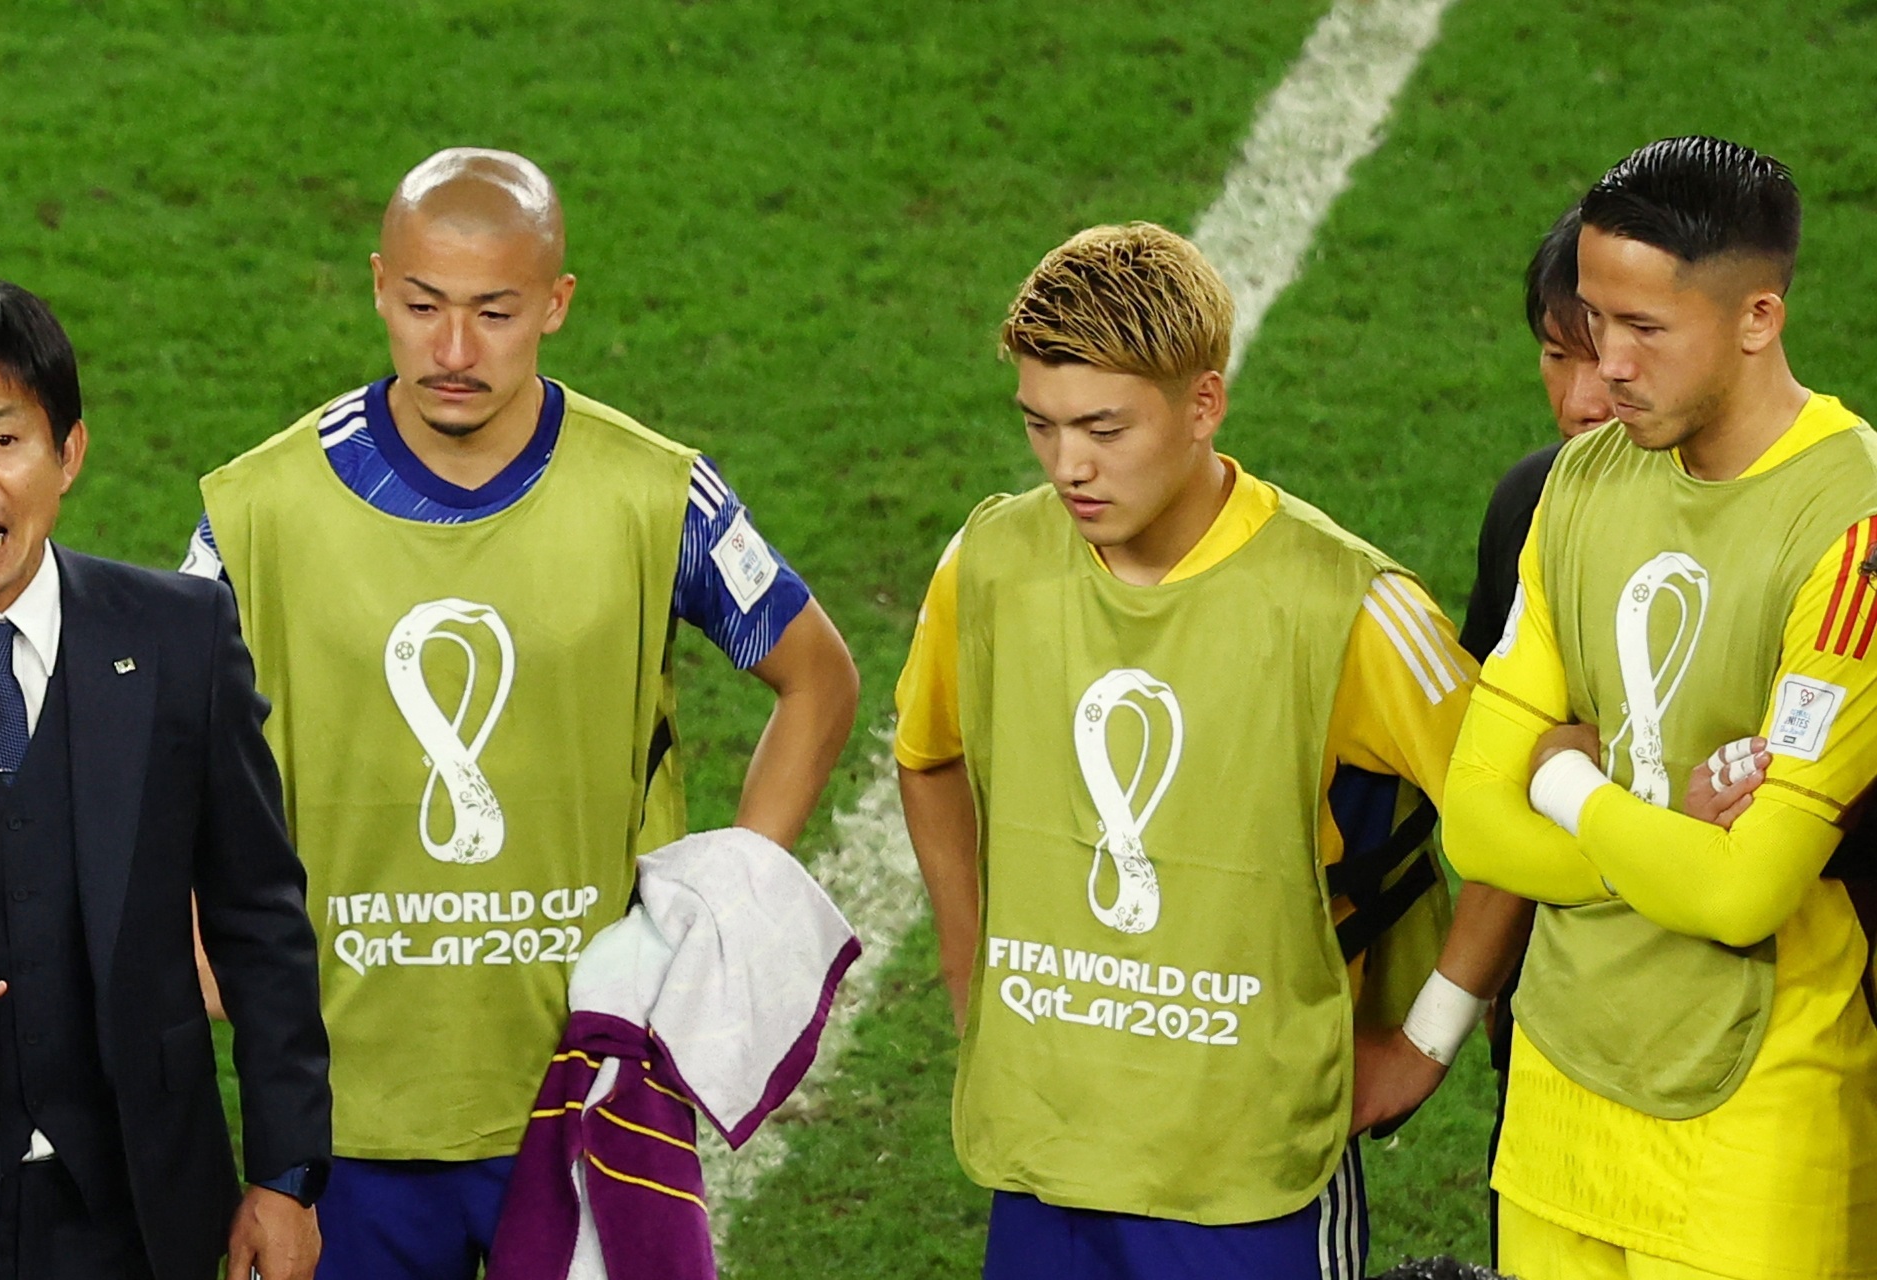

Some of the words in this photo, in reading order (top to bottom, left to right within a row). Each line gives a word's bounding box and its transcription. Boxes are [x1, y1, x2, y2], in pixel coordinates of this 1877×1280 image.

[395, 890, 535, 923] WORLD
[541, 885, 599, 921] CUP
[334, 926, 582, 976] Qatar2022
[988, 937, 1058, 977] FIFA
[1063, 948, 1186, 997] WORLD
[1191, 970, 1261, 1005] CUP
[999, 975, 1239, 1045] Qatar2022
